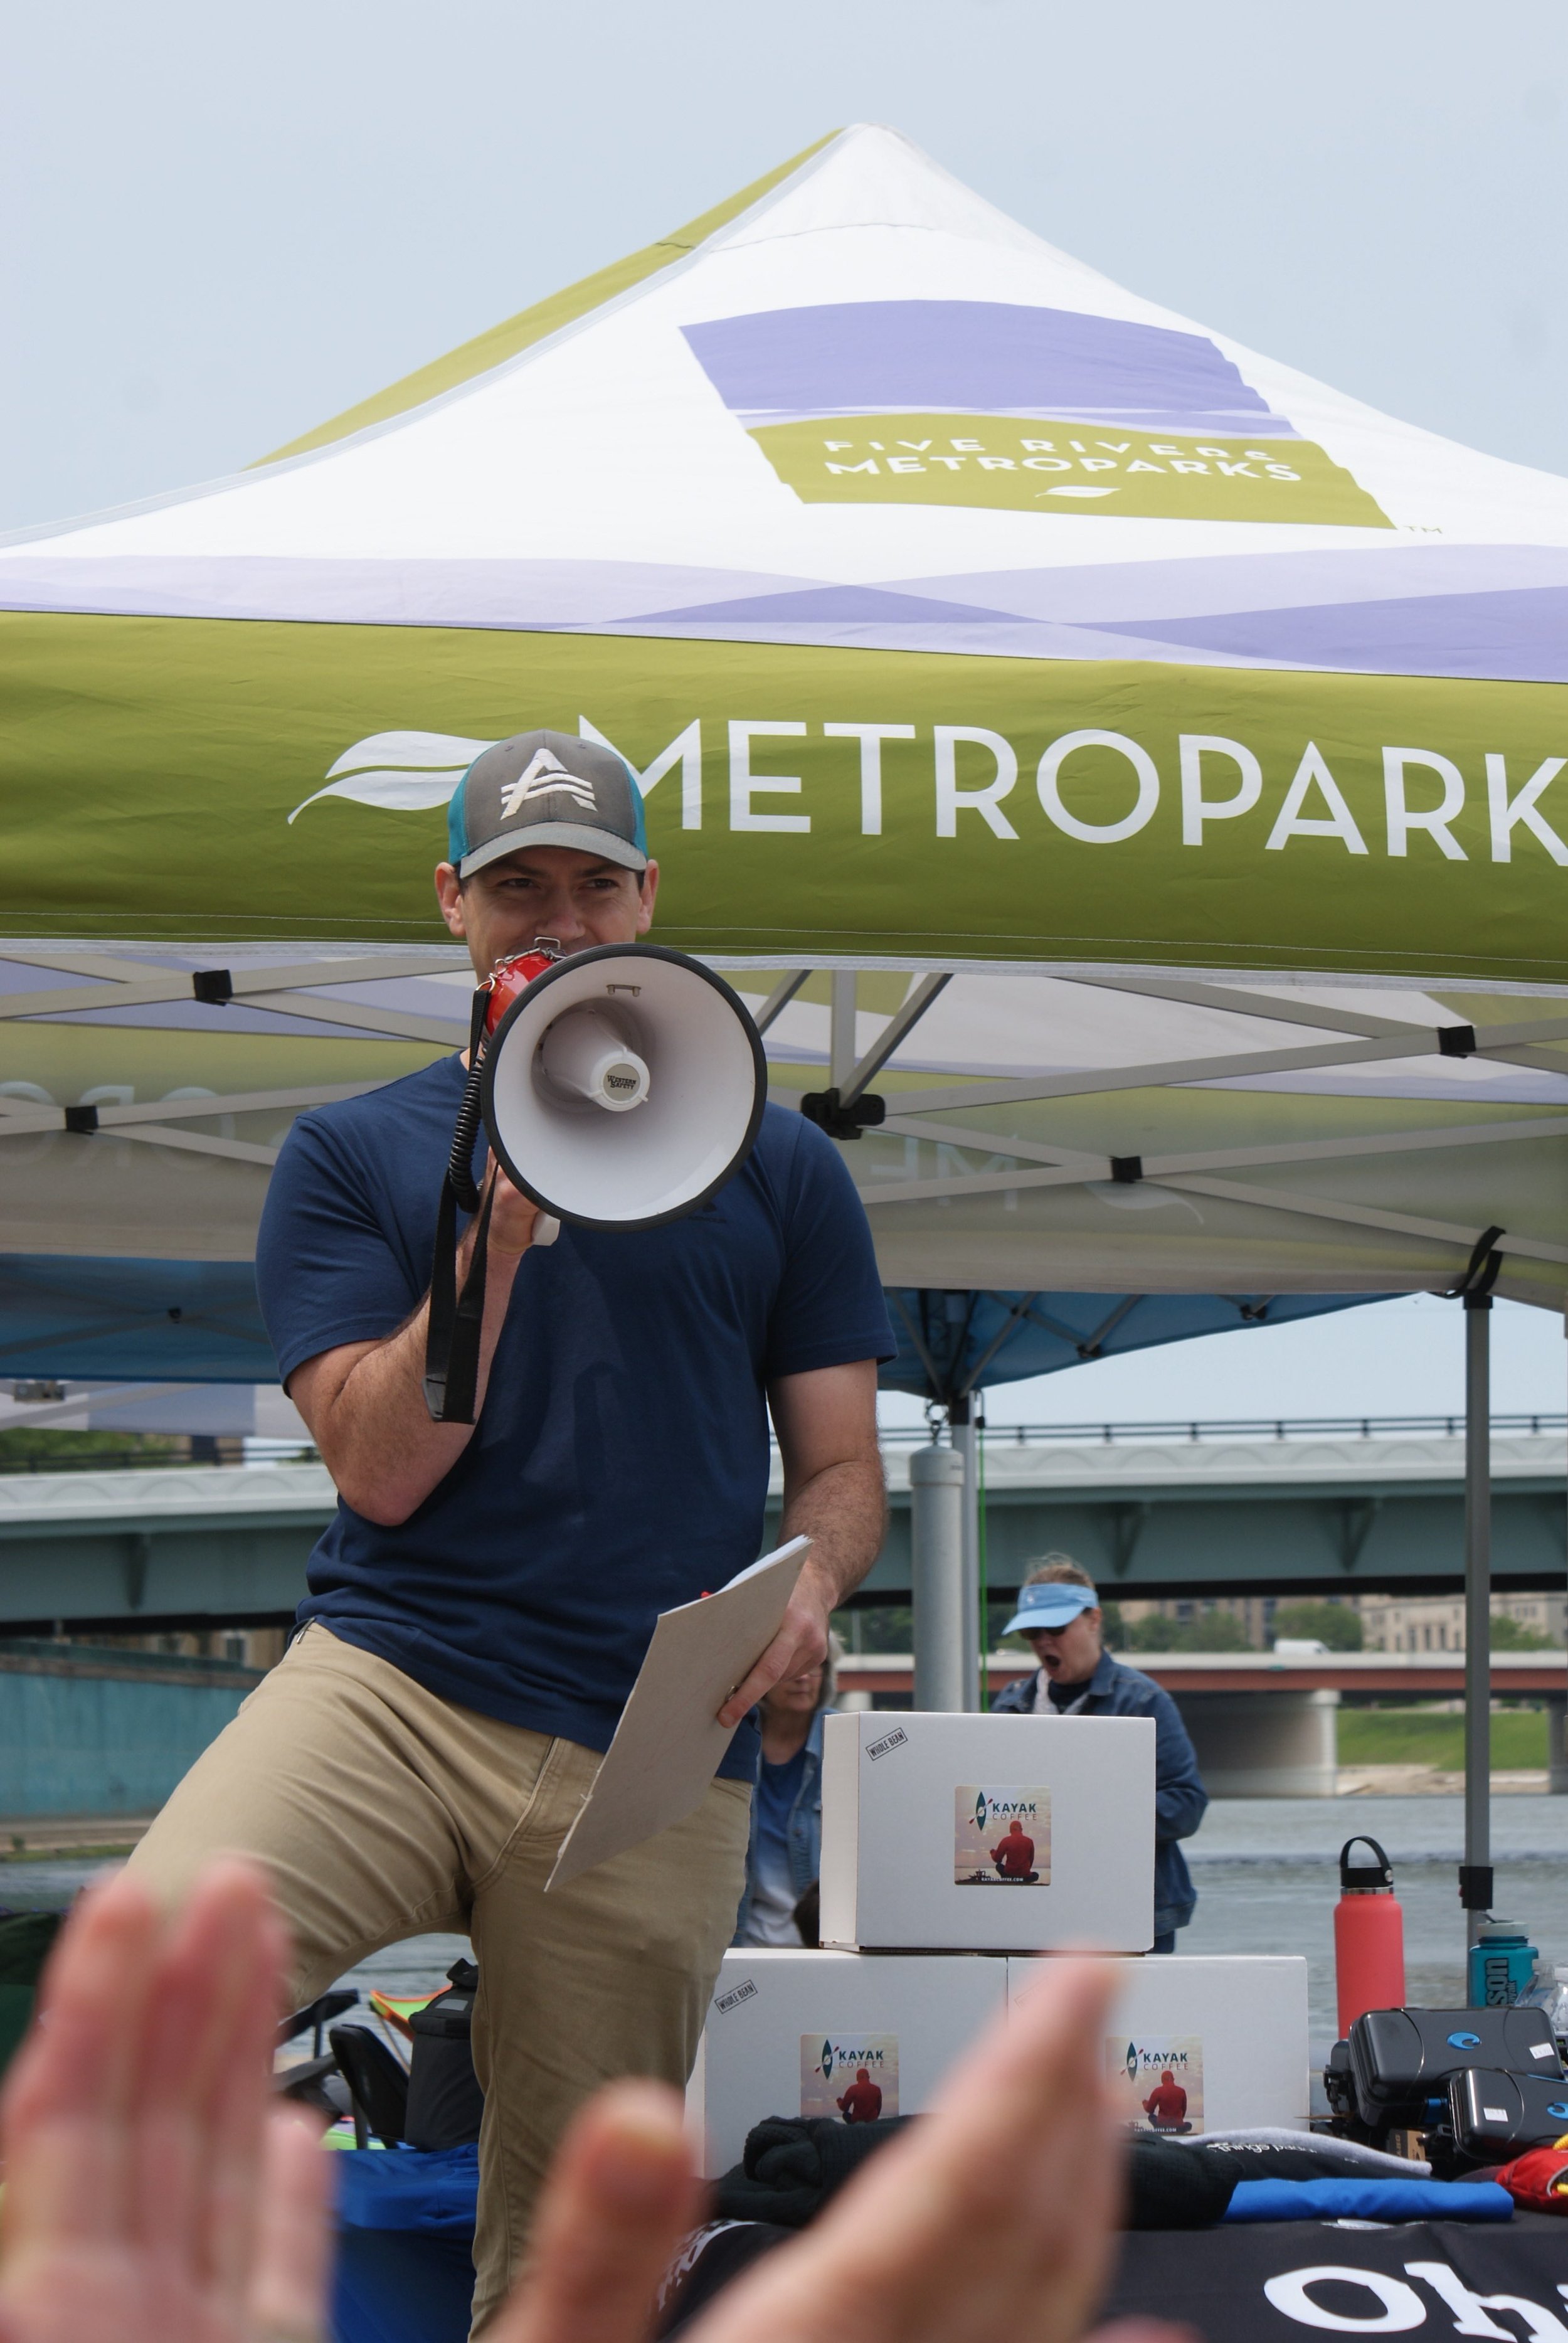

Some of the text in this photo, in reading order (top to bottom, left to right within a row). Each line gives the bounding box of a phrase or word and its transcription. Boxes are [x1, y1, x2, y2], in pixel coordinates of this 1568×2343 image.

[824, 439, 1276, 462] FIVE RIVERS
[824, 457, 1302, 481] METROPARKS
[578, 714, 1568, 867] METROPARK
[607, 1075, 637, 1085] WESTERN
[610, 1081, 634, 1090] SAFETY
[869, 1731, 904, 1757] WHOLE BEAN
[992, 1803, 1036, 1812] KAYAK
[718, 1984, 754, 2009] WHOLE BEAN
[839, 2051, 883, 2060] KAYAK
[1143, 2053, 1187, 2063] KAYAK
[1263, 2261, 1568, 2343] Oh
